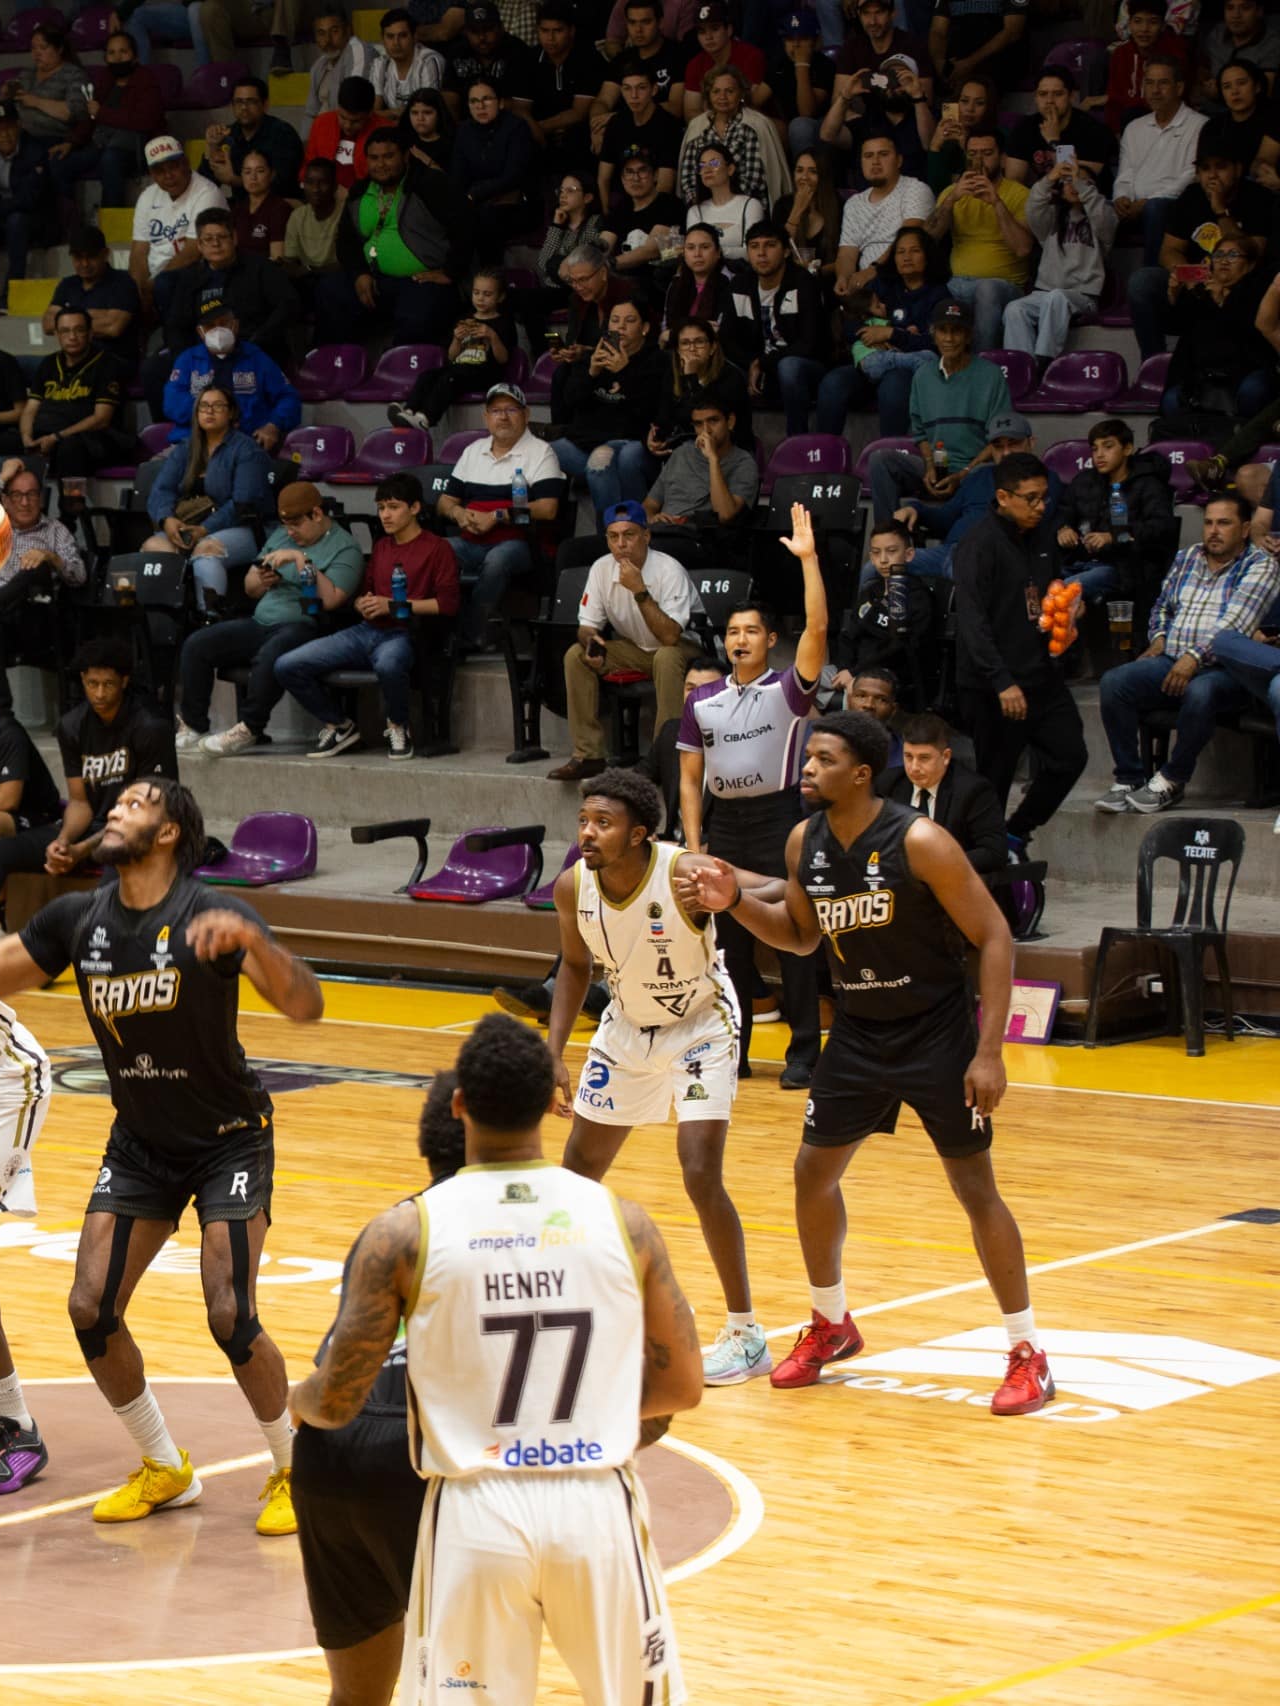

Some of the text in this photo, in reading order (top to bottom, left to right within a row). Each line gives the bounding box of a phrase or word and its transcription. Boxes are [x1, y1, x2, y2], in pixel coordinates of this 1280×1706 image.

[334, 356, 343, 368] 4
[409, 355, 418, 369] 5
[1082, 365, 1100, 379] 13
[316, 438, 325, 452] 5
[394, 441, 404, 455] 6
[807, 448, 821, 463] 11
[1168, 451, 1185, 465] 15
[1075, 457, 1094, 470] 14
[812, 485, 842, 499] R 14
[144, 563, 163, 576] R8
[700, 580, 730, 594] R 16
[723, 723, 773, 743] CIBACOPA
[724, 772, 764, 790] MEGA
[1183, 844, 1219, 859] TECATE
[814, 889, 895, 936] RAYOS
[656, 956, 676, 981] 4
[88, 967, 181, 1020] RAYOS
[230, 1171, 249, 1202] R
[469, 1232, 537, 1253] empeña
[483, 1269, 565, 1301] HENRY
[480, 1307, 594, 1428] 77
[504, 1437, 603, 1467] debate
